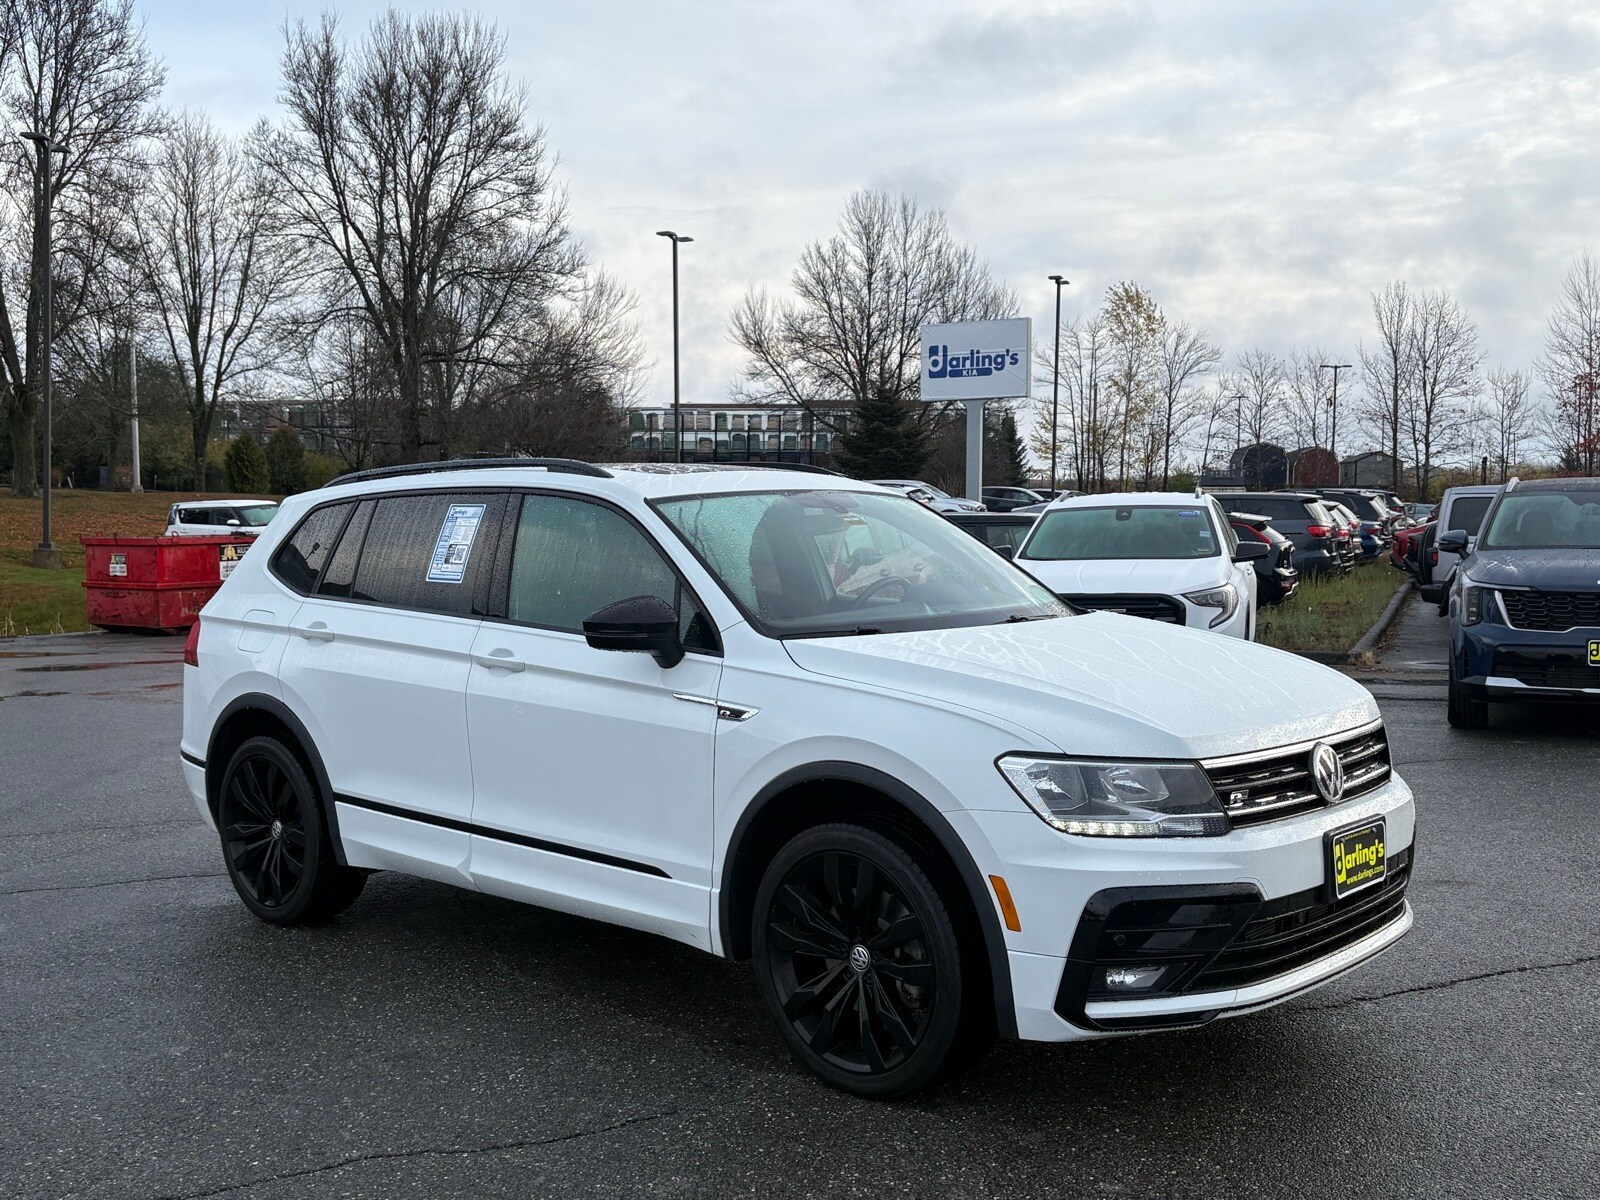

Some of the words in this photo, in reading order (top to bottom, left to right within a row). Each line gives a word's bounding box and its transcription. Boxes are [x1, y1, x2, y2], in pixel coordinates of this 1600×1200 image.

[928, 345, 1019, 378] darling's
[962, 369, 978, 377] KIA
[1335, 839, 1385, 884] darling's
[1346, 865, 1385, 884] www.darlings.com
